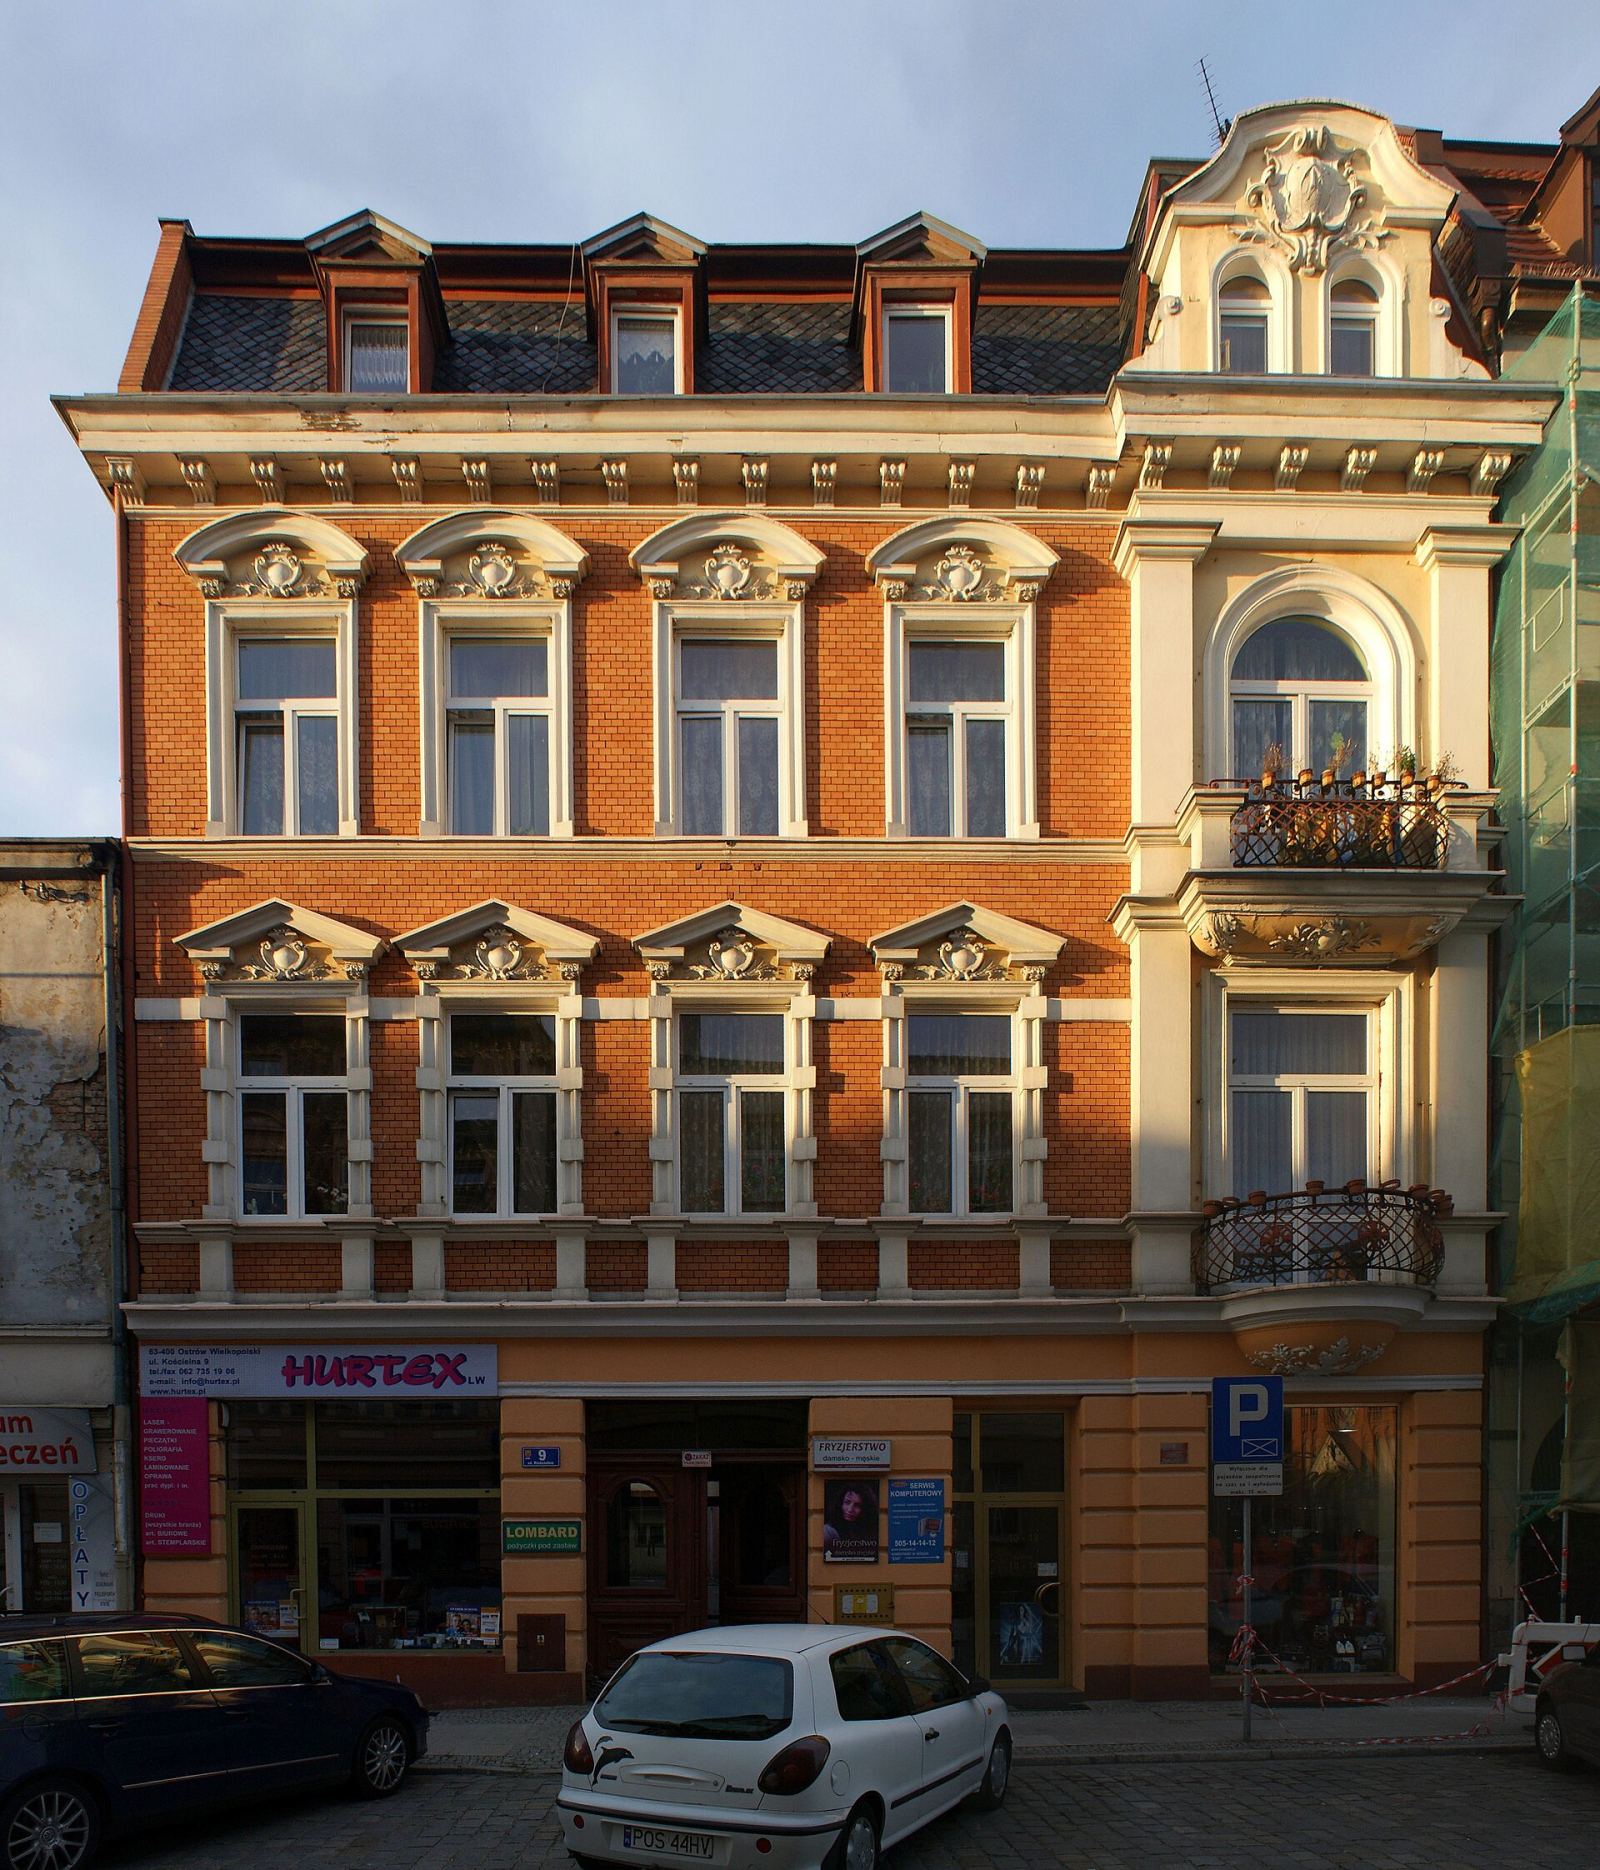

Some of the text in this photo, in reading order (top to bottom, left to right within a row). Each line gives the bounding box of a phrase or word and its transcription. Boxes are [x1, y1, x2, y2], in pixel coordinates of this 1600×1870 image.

[178, 1347, 207, 1355] Ostrów
[210, 1348, 261, 1357] Wielkopolski
[162, 1357, 201, 1365] Kościelna
[281, 1353, 486, 1389] HURTEX LW
[182, 1378, 240, 1386] info@hurtex.pl
[150, 1387, 206, 1396] www.hurtex.pl
[1229, 1384, 1269, 1437] P
[819, 1442, 886, 1453] FRYZJERSTWO
[538, 1449, 547, 1461] 9
[506, 1527, 577, 1538] LOMBARD
[72, 1482, 91, 1607] OPŁATY
[633, 1828, 712, 1856] POS 44HV
